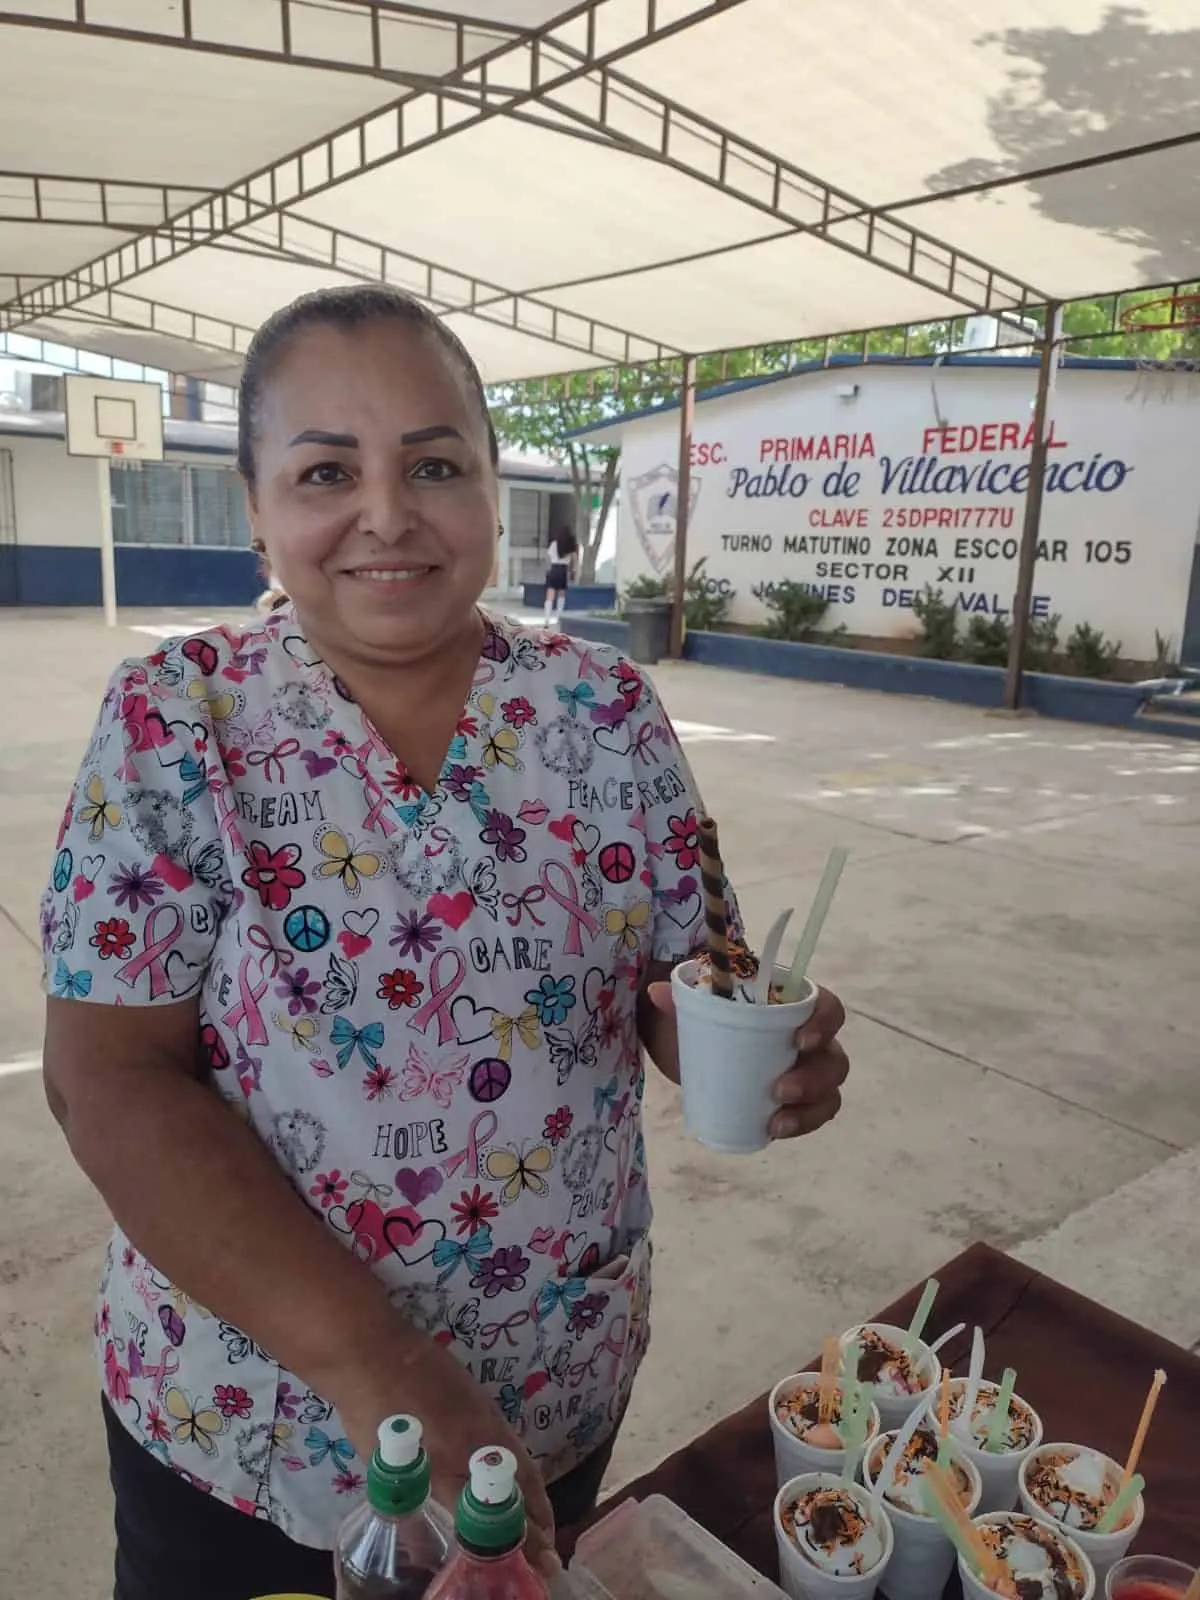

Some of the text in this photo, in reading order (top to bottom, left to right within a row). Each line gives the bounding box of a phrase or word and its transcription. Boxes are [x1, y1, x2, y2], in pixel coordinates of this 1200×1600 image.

[760, 432, 876, 462] PRIMARIA
[726, 464, 813, 498] Pablo
[822, 460, 861, 498] de
[808, 508, 868, 528] CLAVE
[721, 534, 1132, 564] TURNO MATUTINO ZONA ESCOAR 105
[815, 562, 974, 584] SECTOR XII
[960, 591, 1051, 618] VALE
[235, 790, 327, 829] REAM
[468, 936, 553, 974] CARE
[371, 1118, 449, 1161] HOPE
